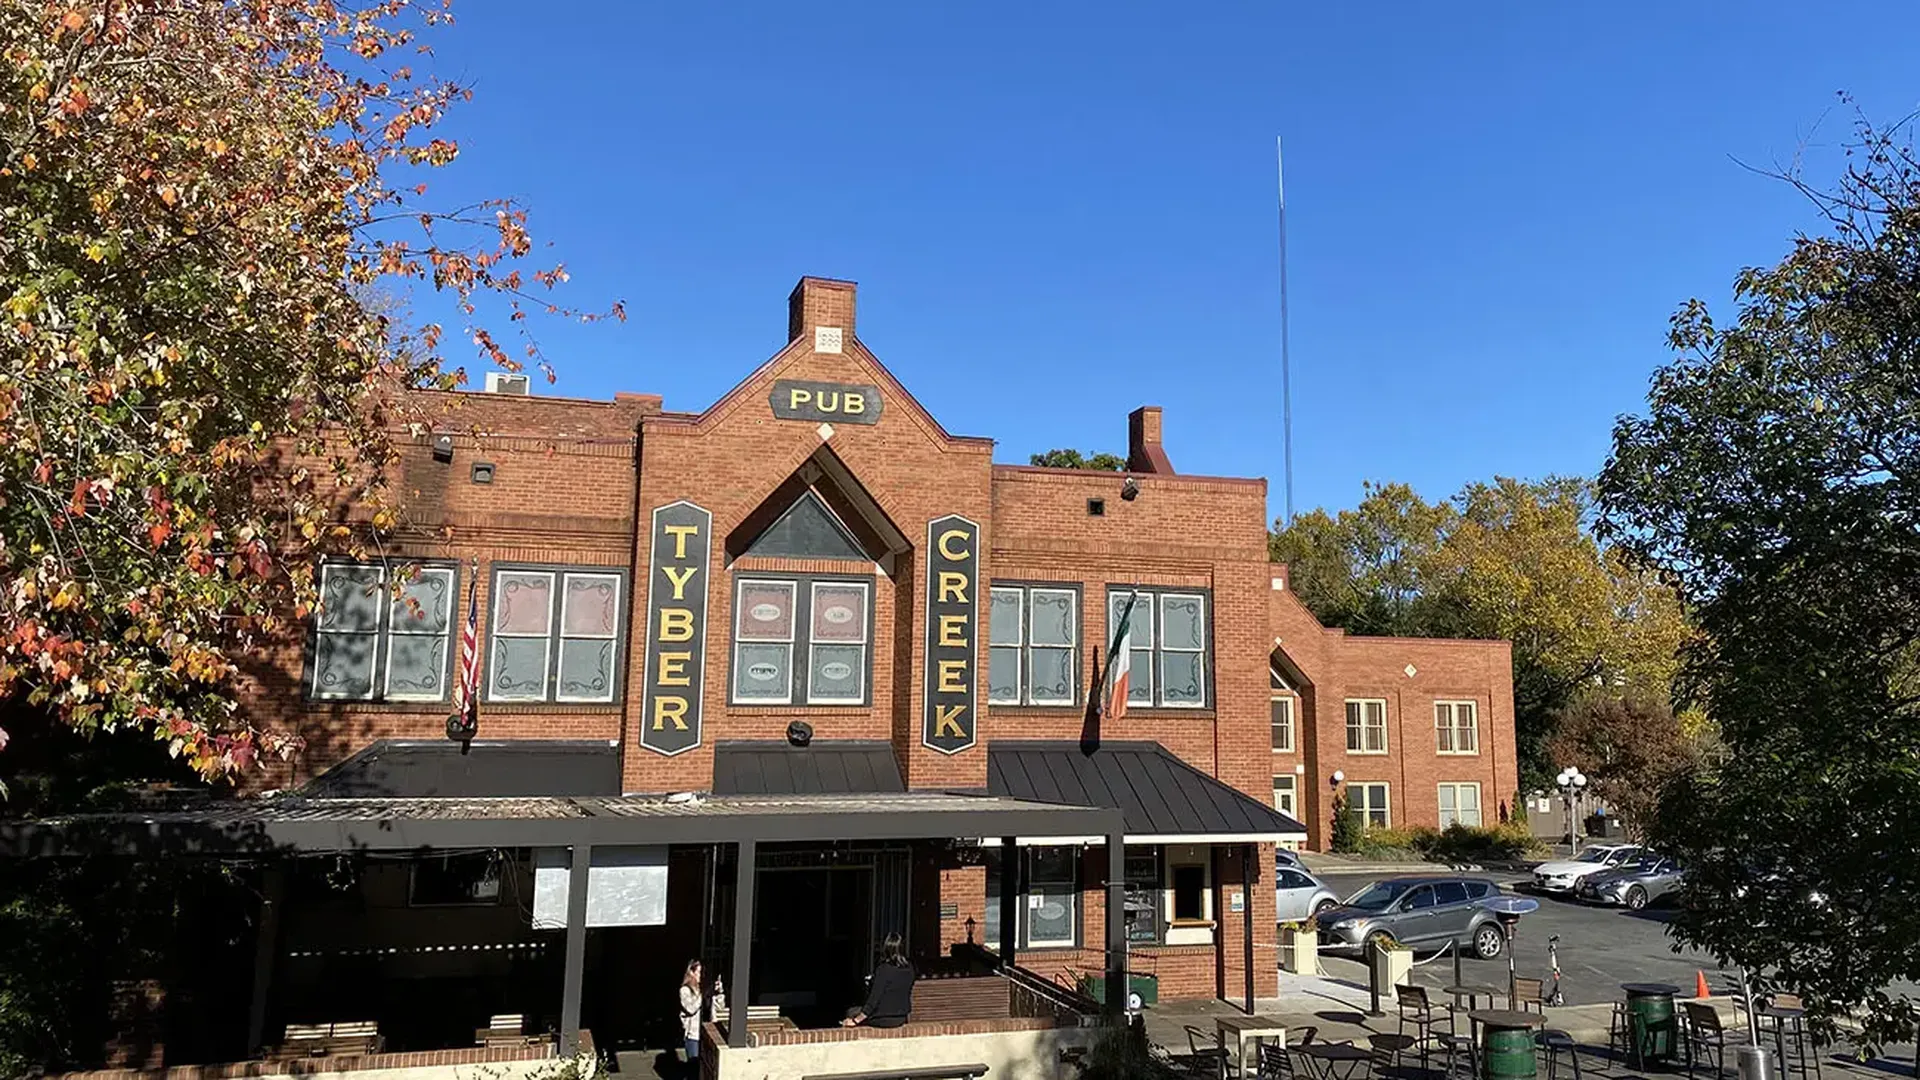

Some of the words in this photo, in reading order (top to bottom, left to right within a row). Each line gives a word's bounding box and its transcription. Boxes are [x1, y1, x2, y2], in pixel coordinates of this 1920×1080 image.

[789, 388, 865, 413] PUB
[652, 524, 698, 730] TYBER
[934, 529, 970, 737] CREEK
